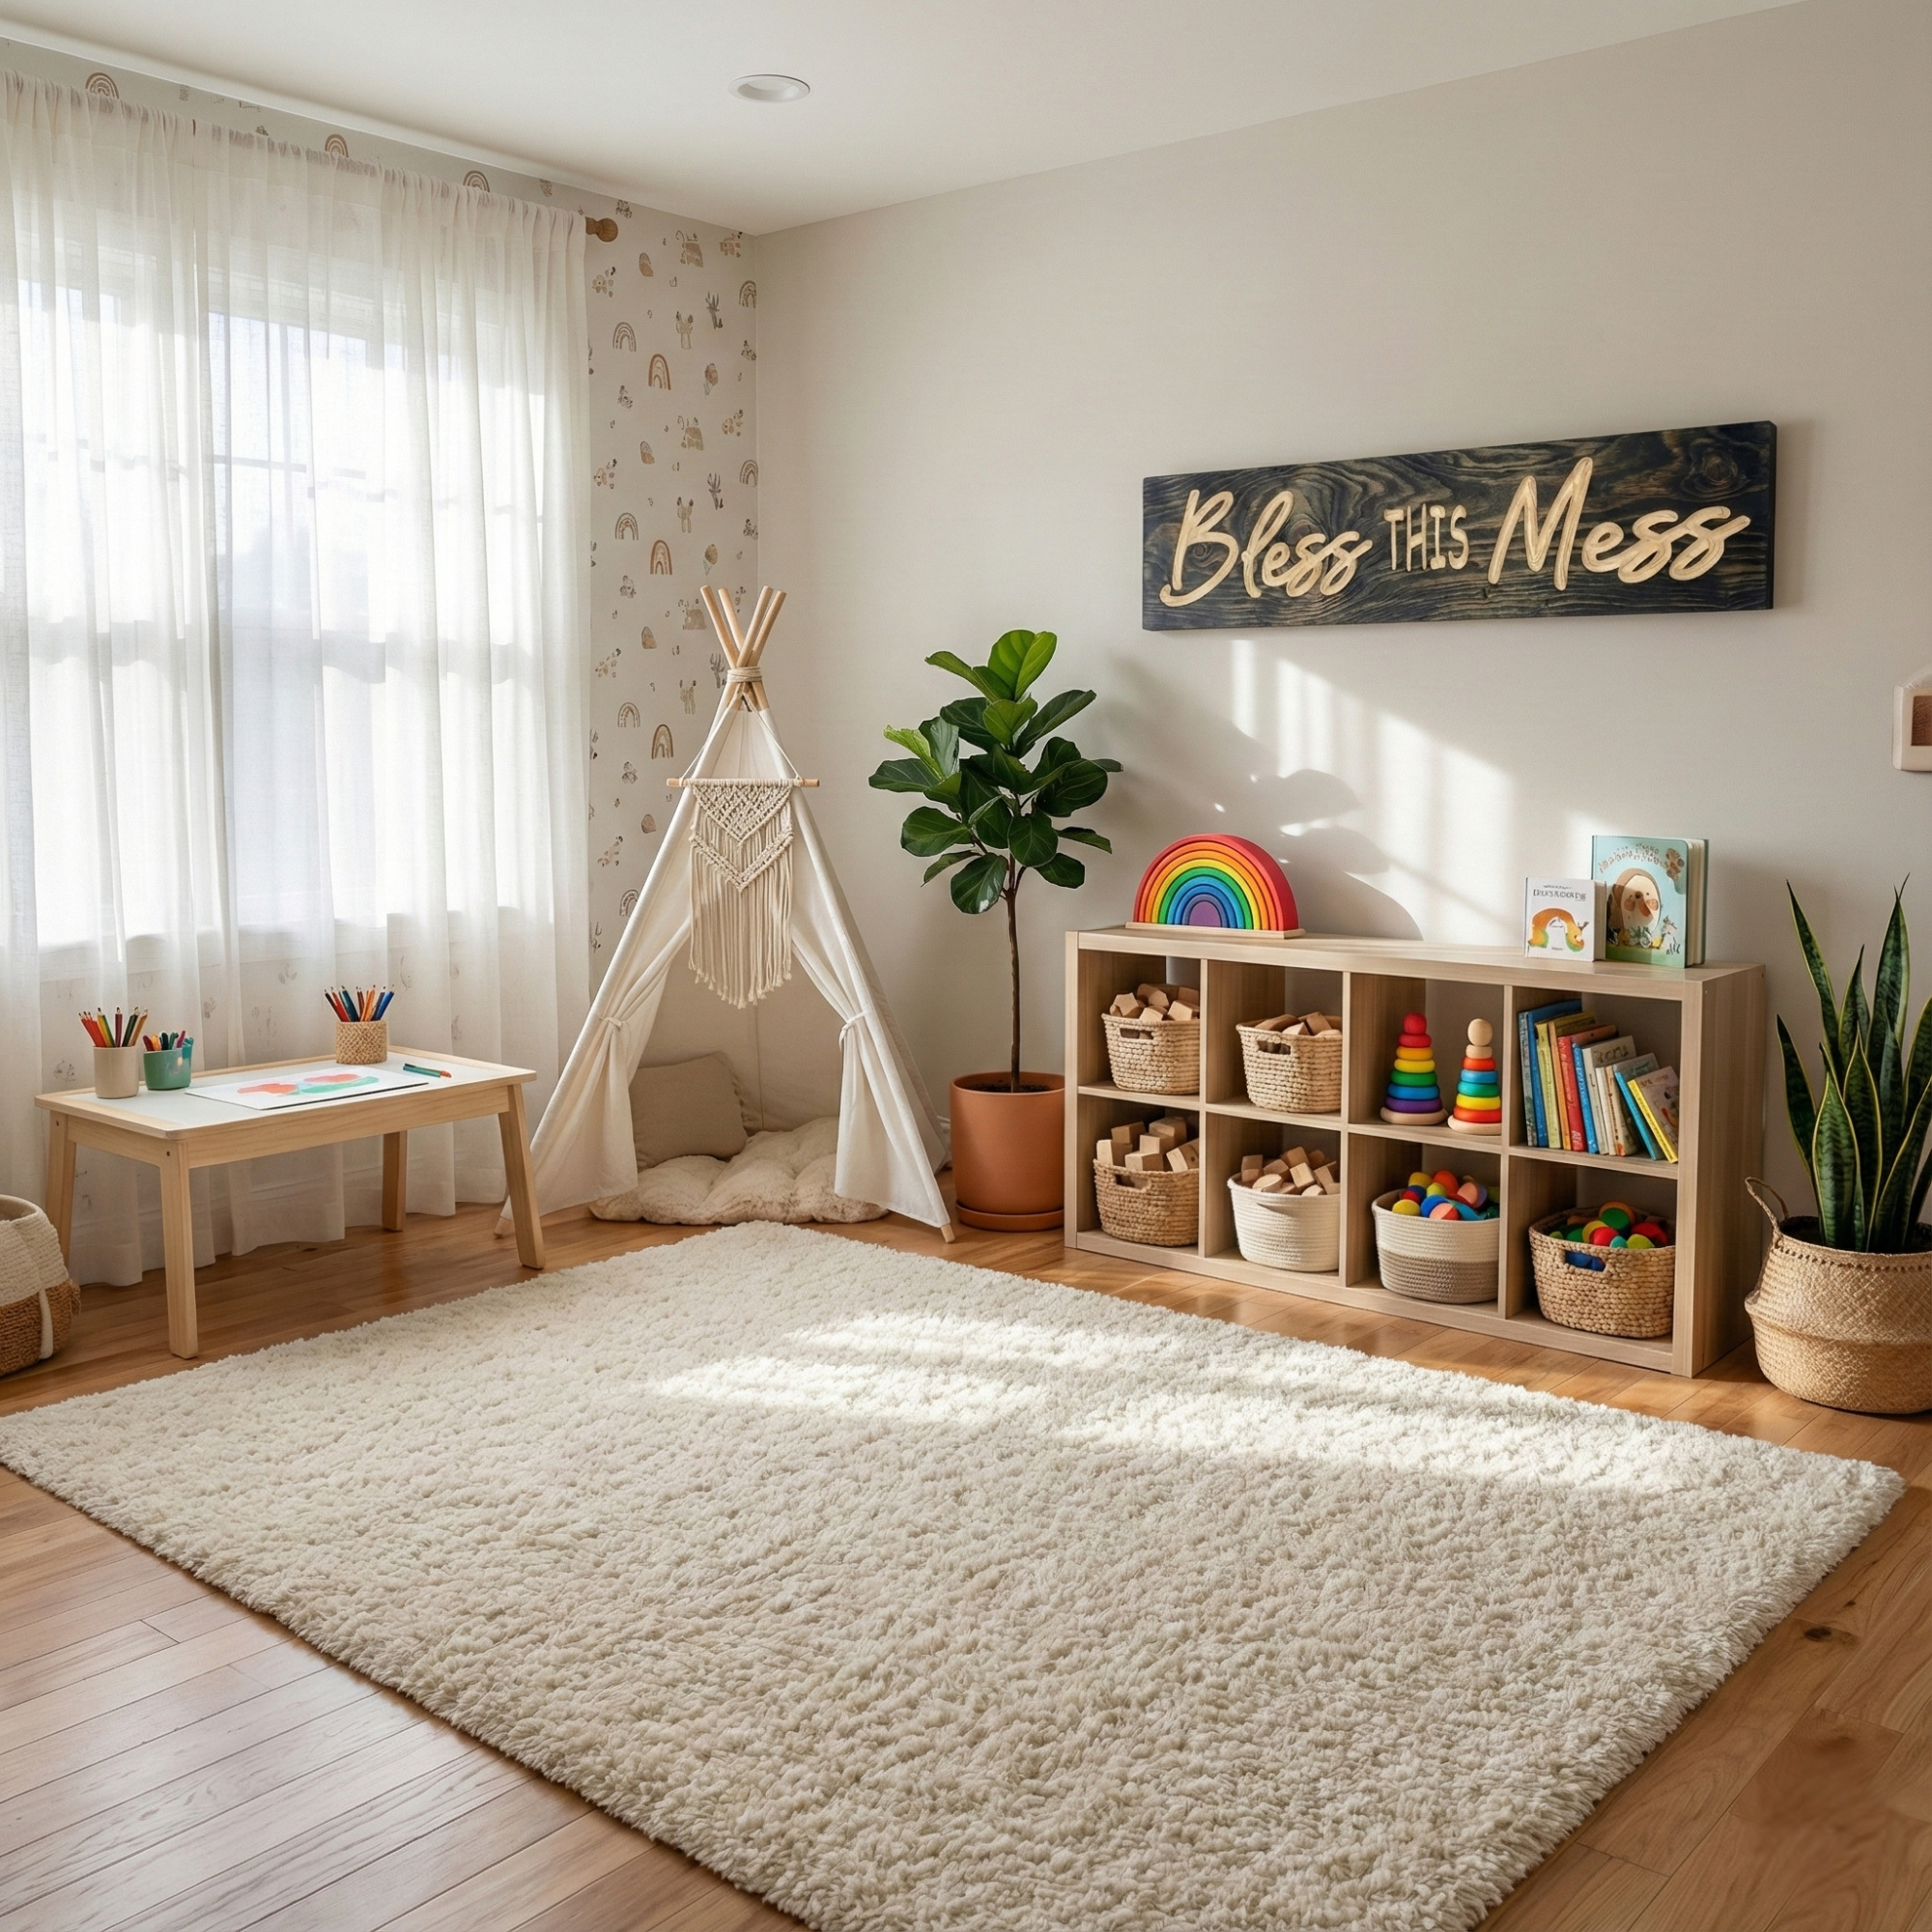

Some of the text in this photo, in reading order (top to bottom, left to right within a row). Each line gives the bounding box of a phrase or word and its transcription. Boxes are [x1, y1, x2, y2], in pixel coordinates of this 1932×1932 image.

[1159, 457, 1750, 607] Bless THIS Mess
